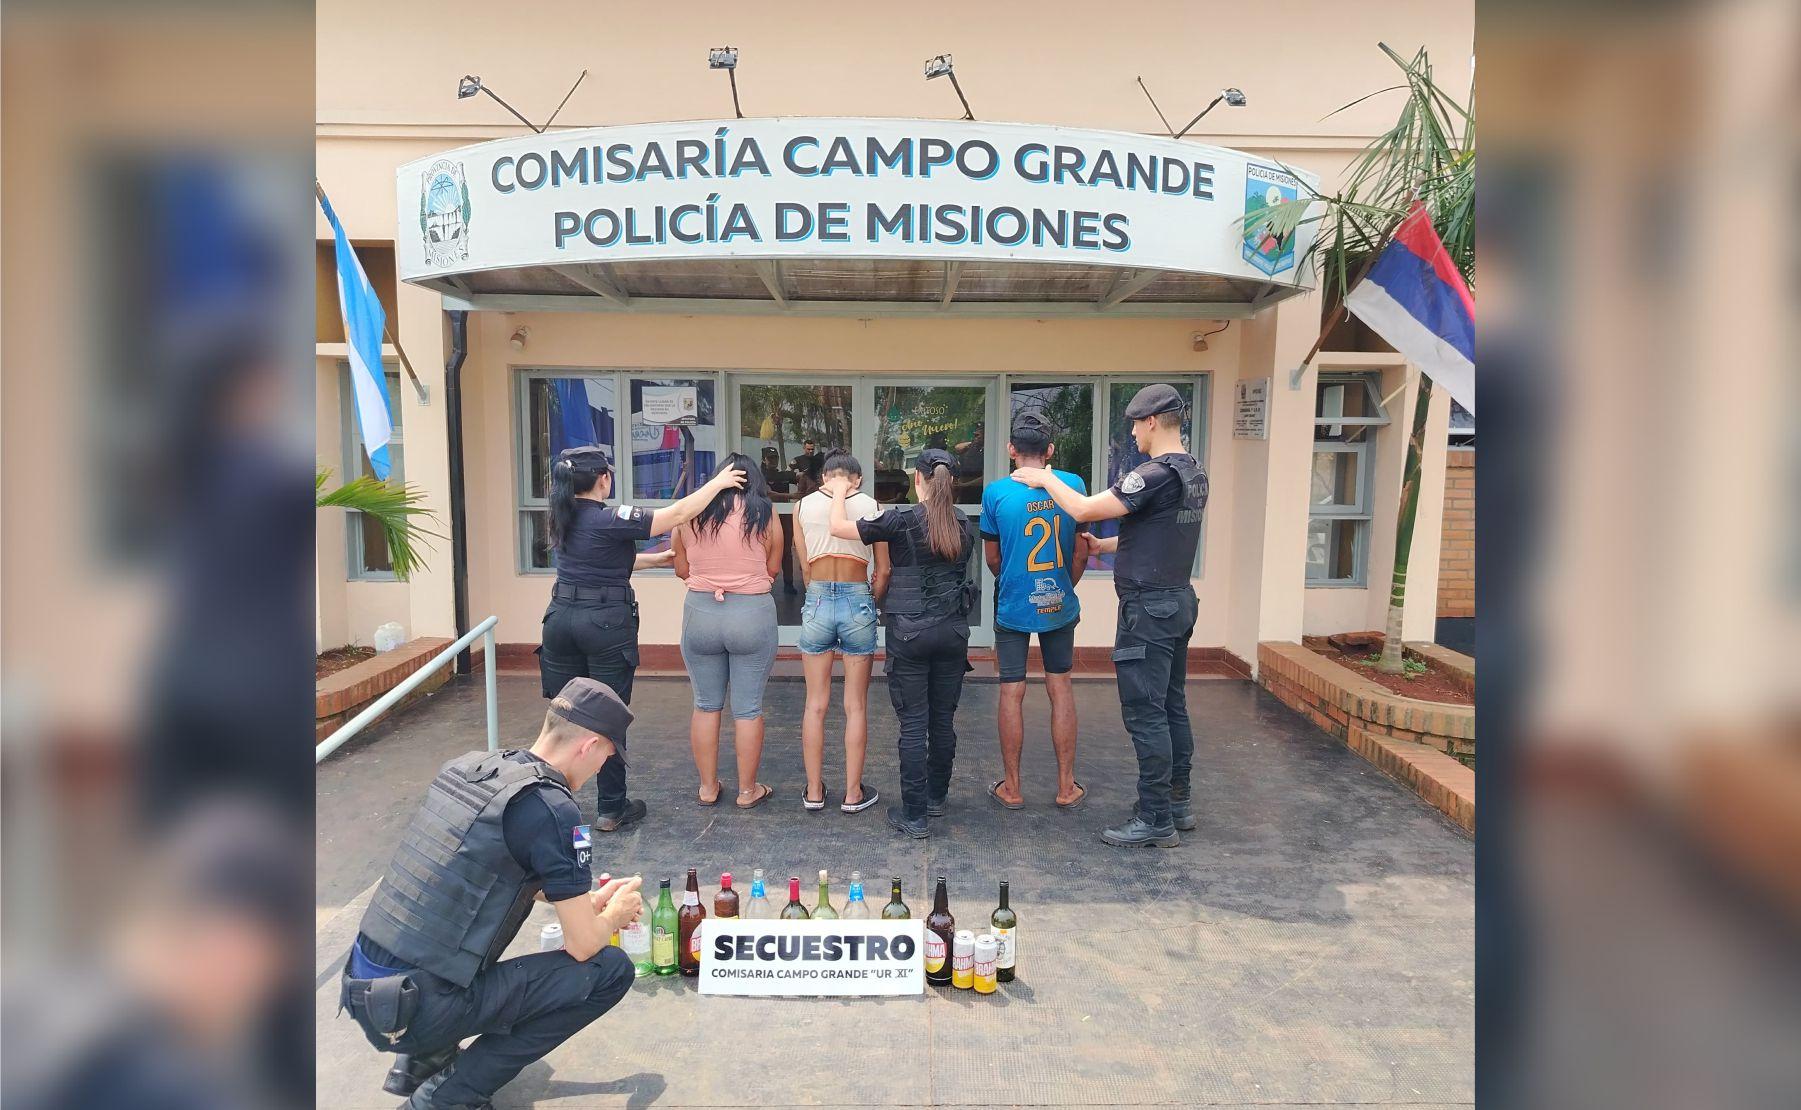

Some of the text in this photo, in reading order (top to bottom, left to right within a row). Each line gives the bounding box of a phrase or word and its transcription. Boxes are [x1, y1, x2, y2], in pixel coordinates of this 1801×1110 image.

[491, 127, 1215, 201] COMISARÍA CAMPO GRANDE
[1248, 166, 1268, 179] POLICIA
[1268, 171, 1275, 181] DE
[554, 193, 1131, 252] POLICÍA DE MISIONES
[1027, 500, 1055, 512] OSCAR
[1024, 514, 1064, 572] 21
[714, 934, 916, 962] SECUESTRO
[711, 968, 775, 979] COMISARIA
[776, 969, 819, 979] CAMPO
[821, 969, 868, 979] GRANDE
